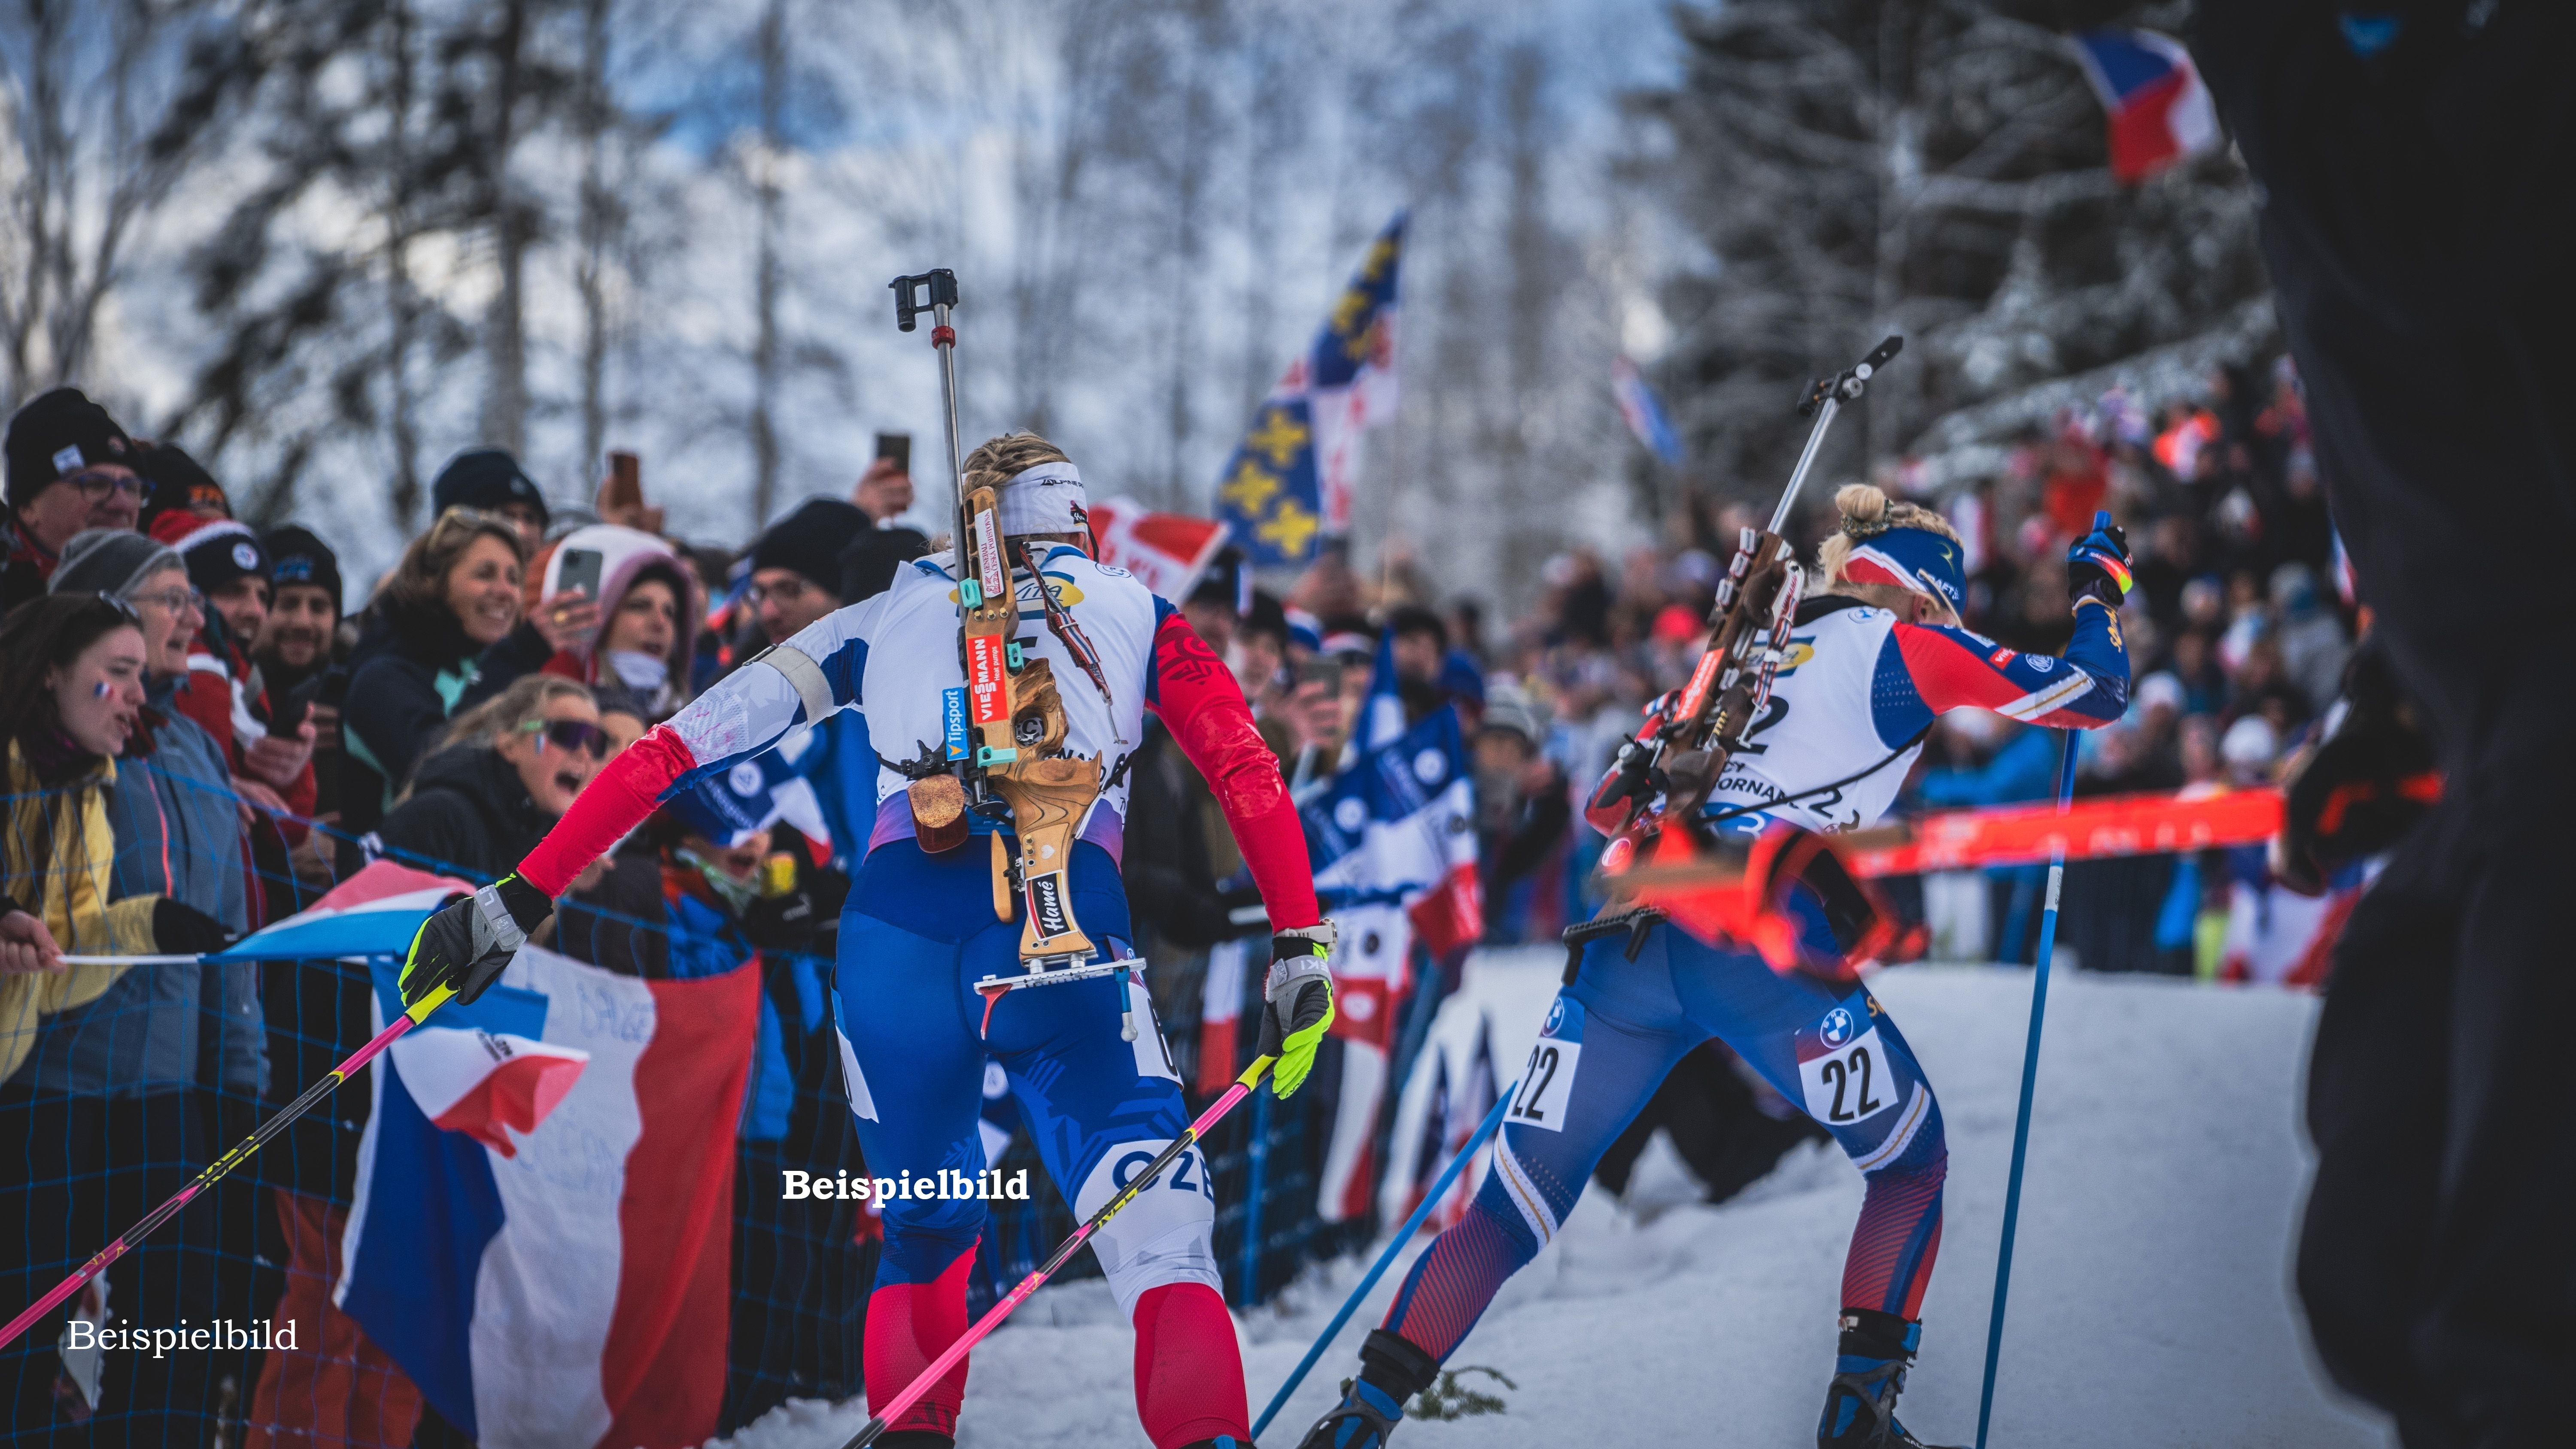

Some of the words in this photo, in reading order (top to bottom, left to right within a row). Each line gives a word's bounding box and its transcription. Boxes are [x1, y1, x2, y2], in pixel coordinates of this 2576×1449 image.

[981, 543, 990, 573] GENERALI
[988, 550, 998, 571] ČESKÁ
[974, 639, 997, 721] VIESSMANN
[992, 646, 1000, 665] pumps
[945, 691, 963, 742] Tipsport
[1037, 881, 1064, 931] Hamé
[1823, 1010, 1846, 1029] BMW
[1511, 1045, 1559, 1122] 22
[1821, 1047, 1880, 1122] 22
